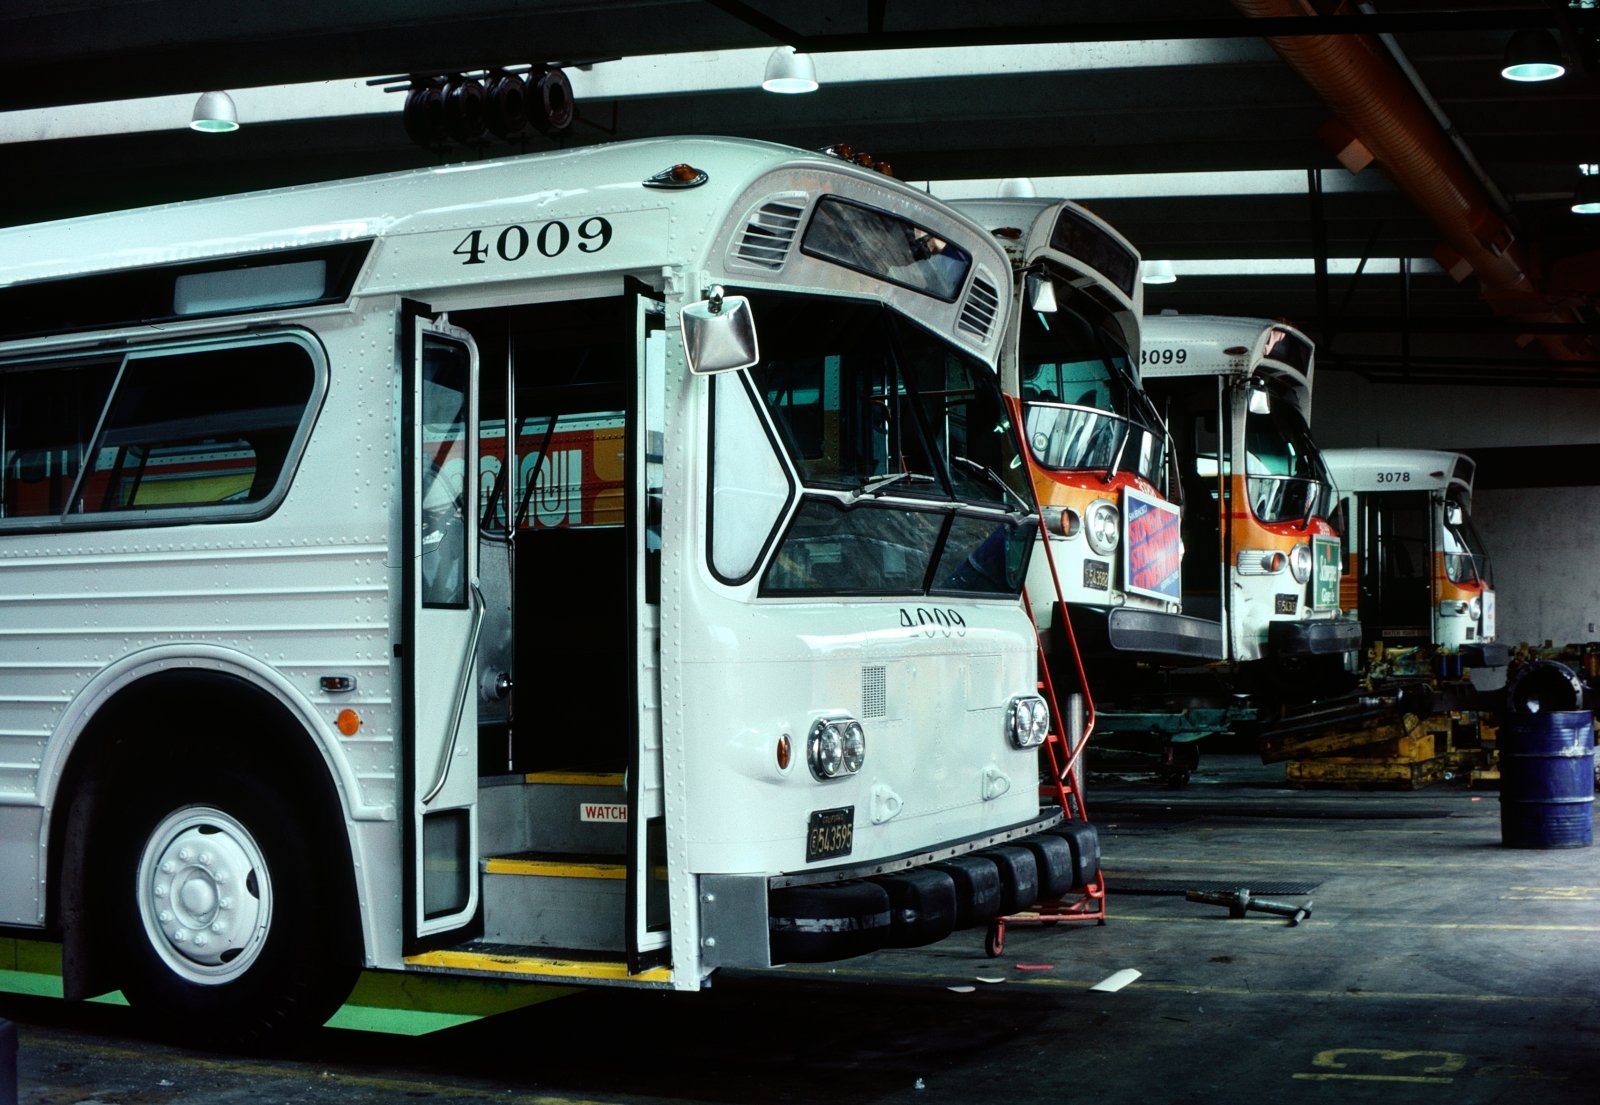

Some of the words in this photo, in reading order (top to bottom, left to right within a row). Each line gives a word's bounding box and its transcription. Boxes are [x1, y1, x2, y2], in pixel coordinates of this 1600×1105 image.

[453, 216, 613, 265] 4009
[1377, 472, 1410, 483] 3078
[900, 608, 966, 637] 4009
[585, 805, 626, 819] WATCH
[818, 823, 852, 853] 543595
